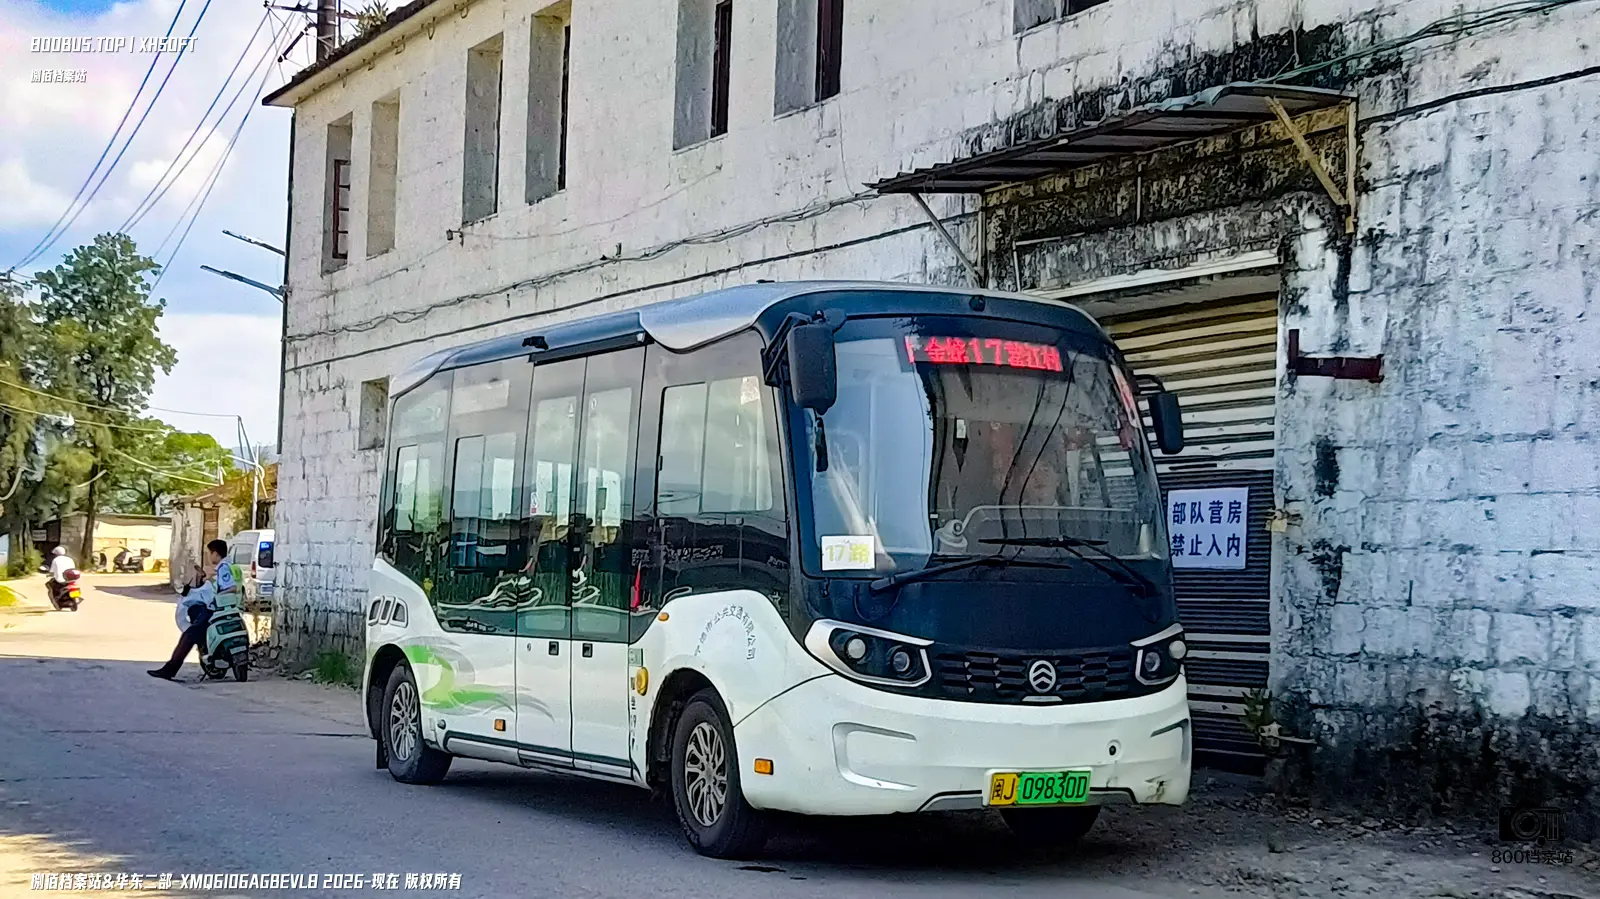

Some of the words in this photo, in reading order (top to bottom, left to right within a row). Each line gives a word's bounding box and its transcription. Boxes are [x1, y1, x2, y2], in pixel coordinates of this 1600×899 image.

[1172, 499, 1242, 525] 部队营房
[825, 543, 870, 564] 17路
[1171, 532, 1241, 558] 禁止入内
